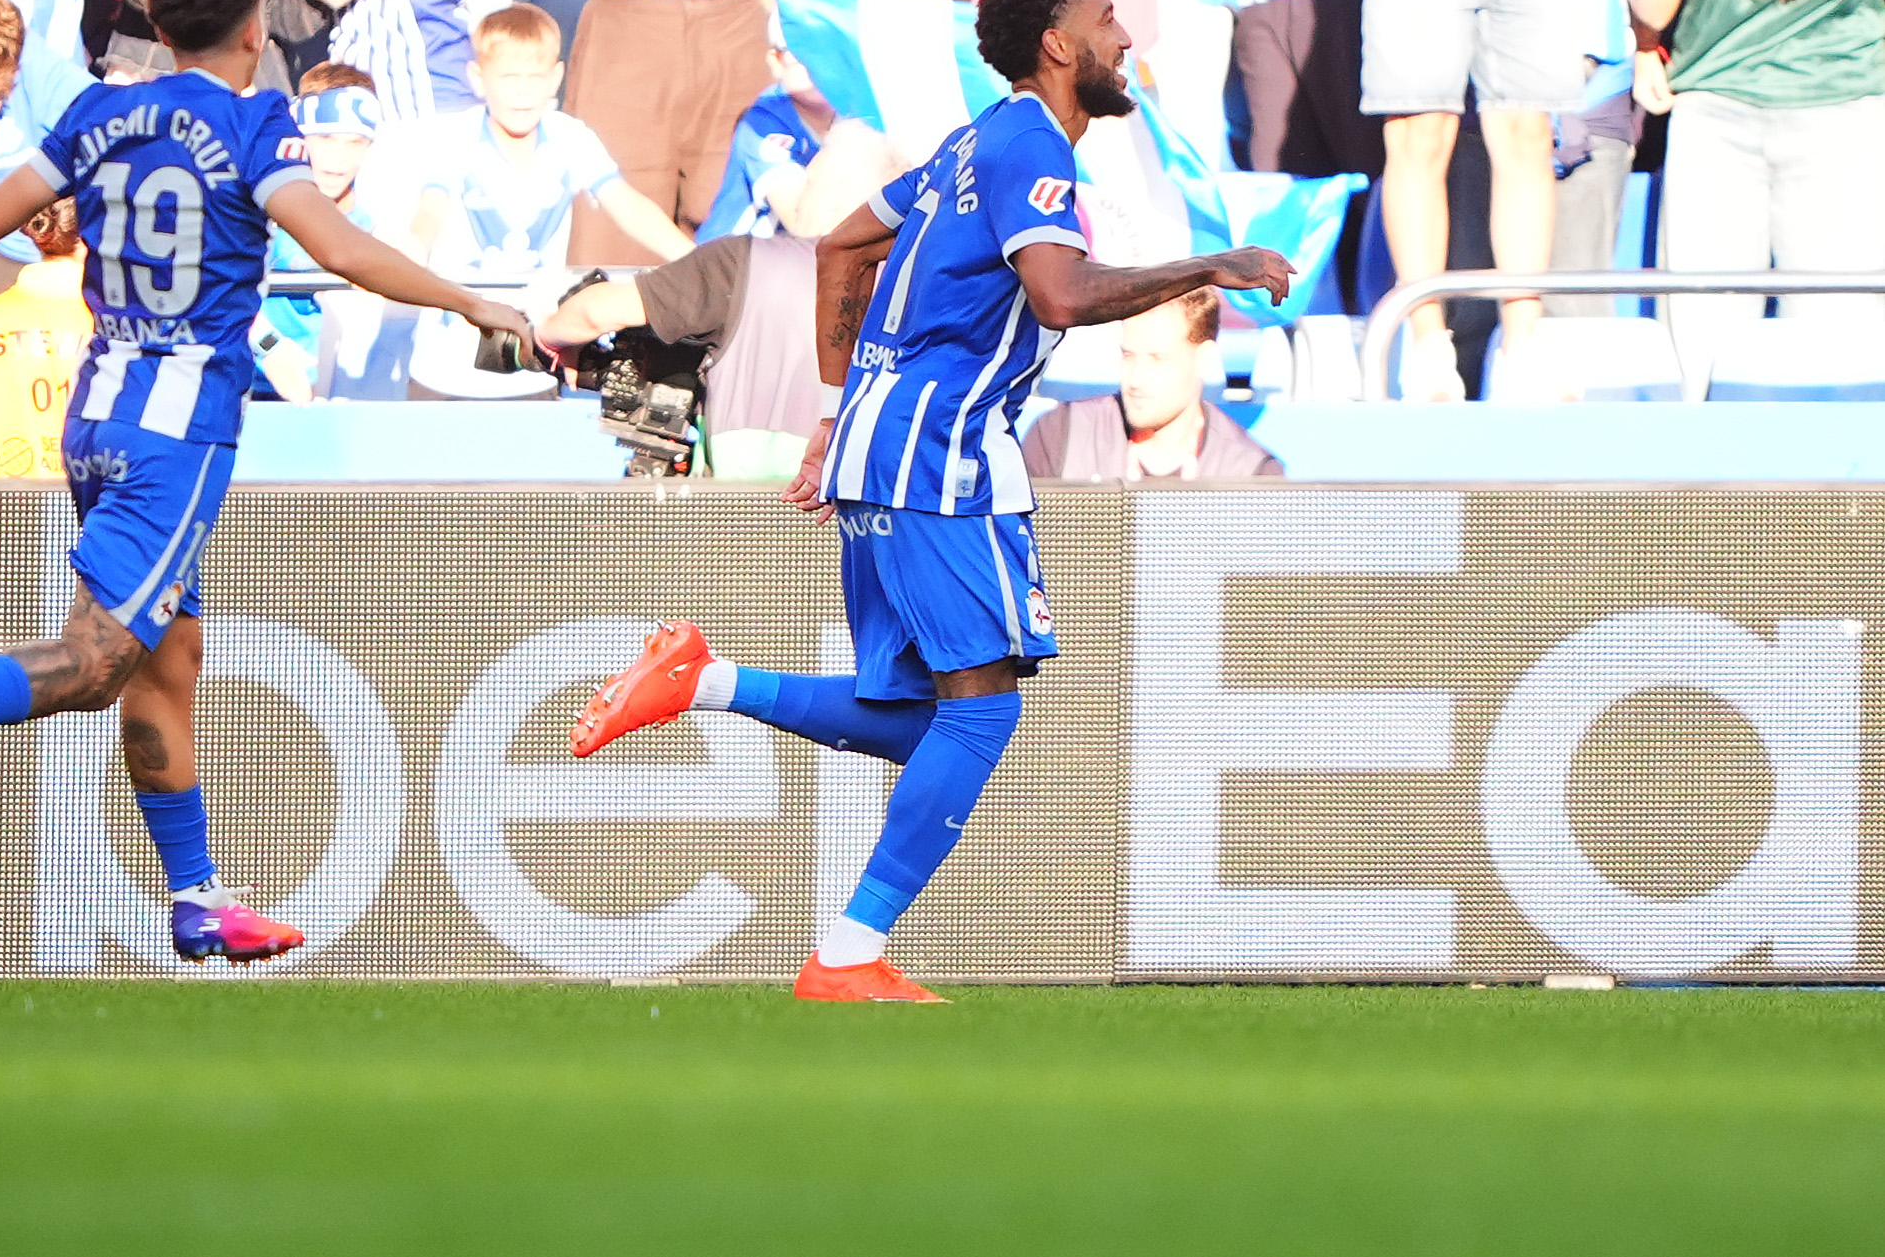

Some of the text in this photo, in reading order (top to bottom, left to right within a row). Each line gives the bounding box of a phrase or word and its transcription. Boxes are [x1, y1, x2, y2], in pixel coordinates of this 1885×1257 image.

[169, 108, 241, 190] CRUZ
[90, 160, 205, 318] 19
[881, 186, 942, 335] 7
